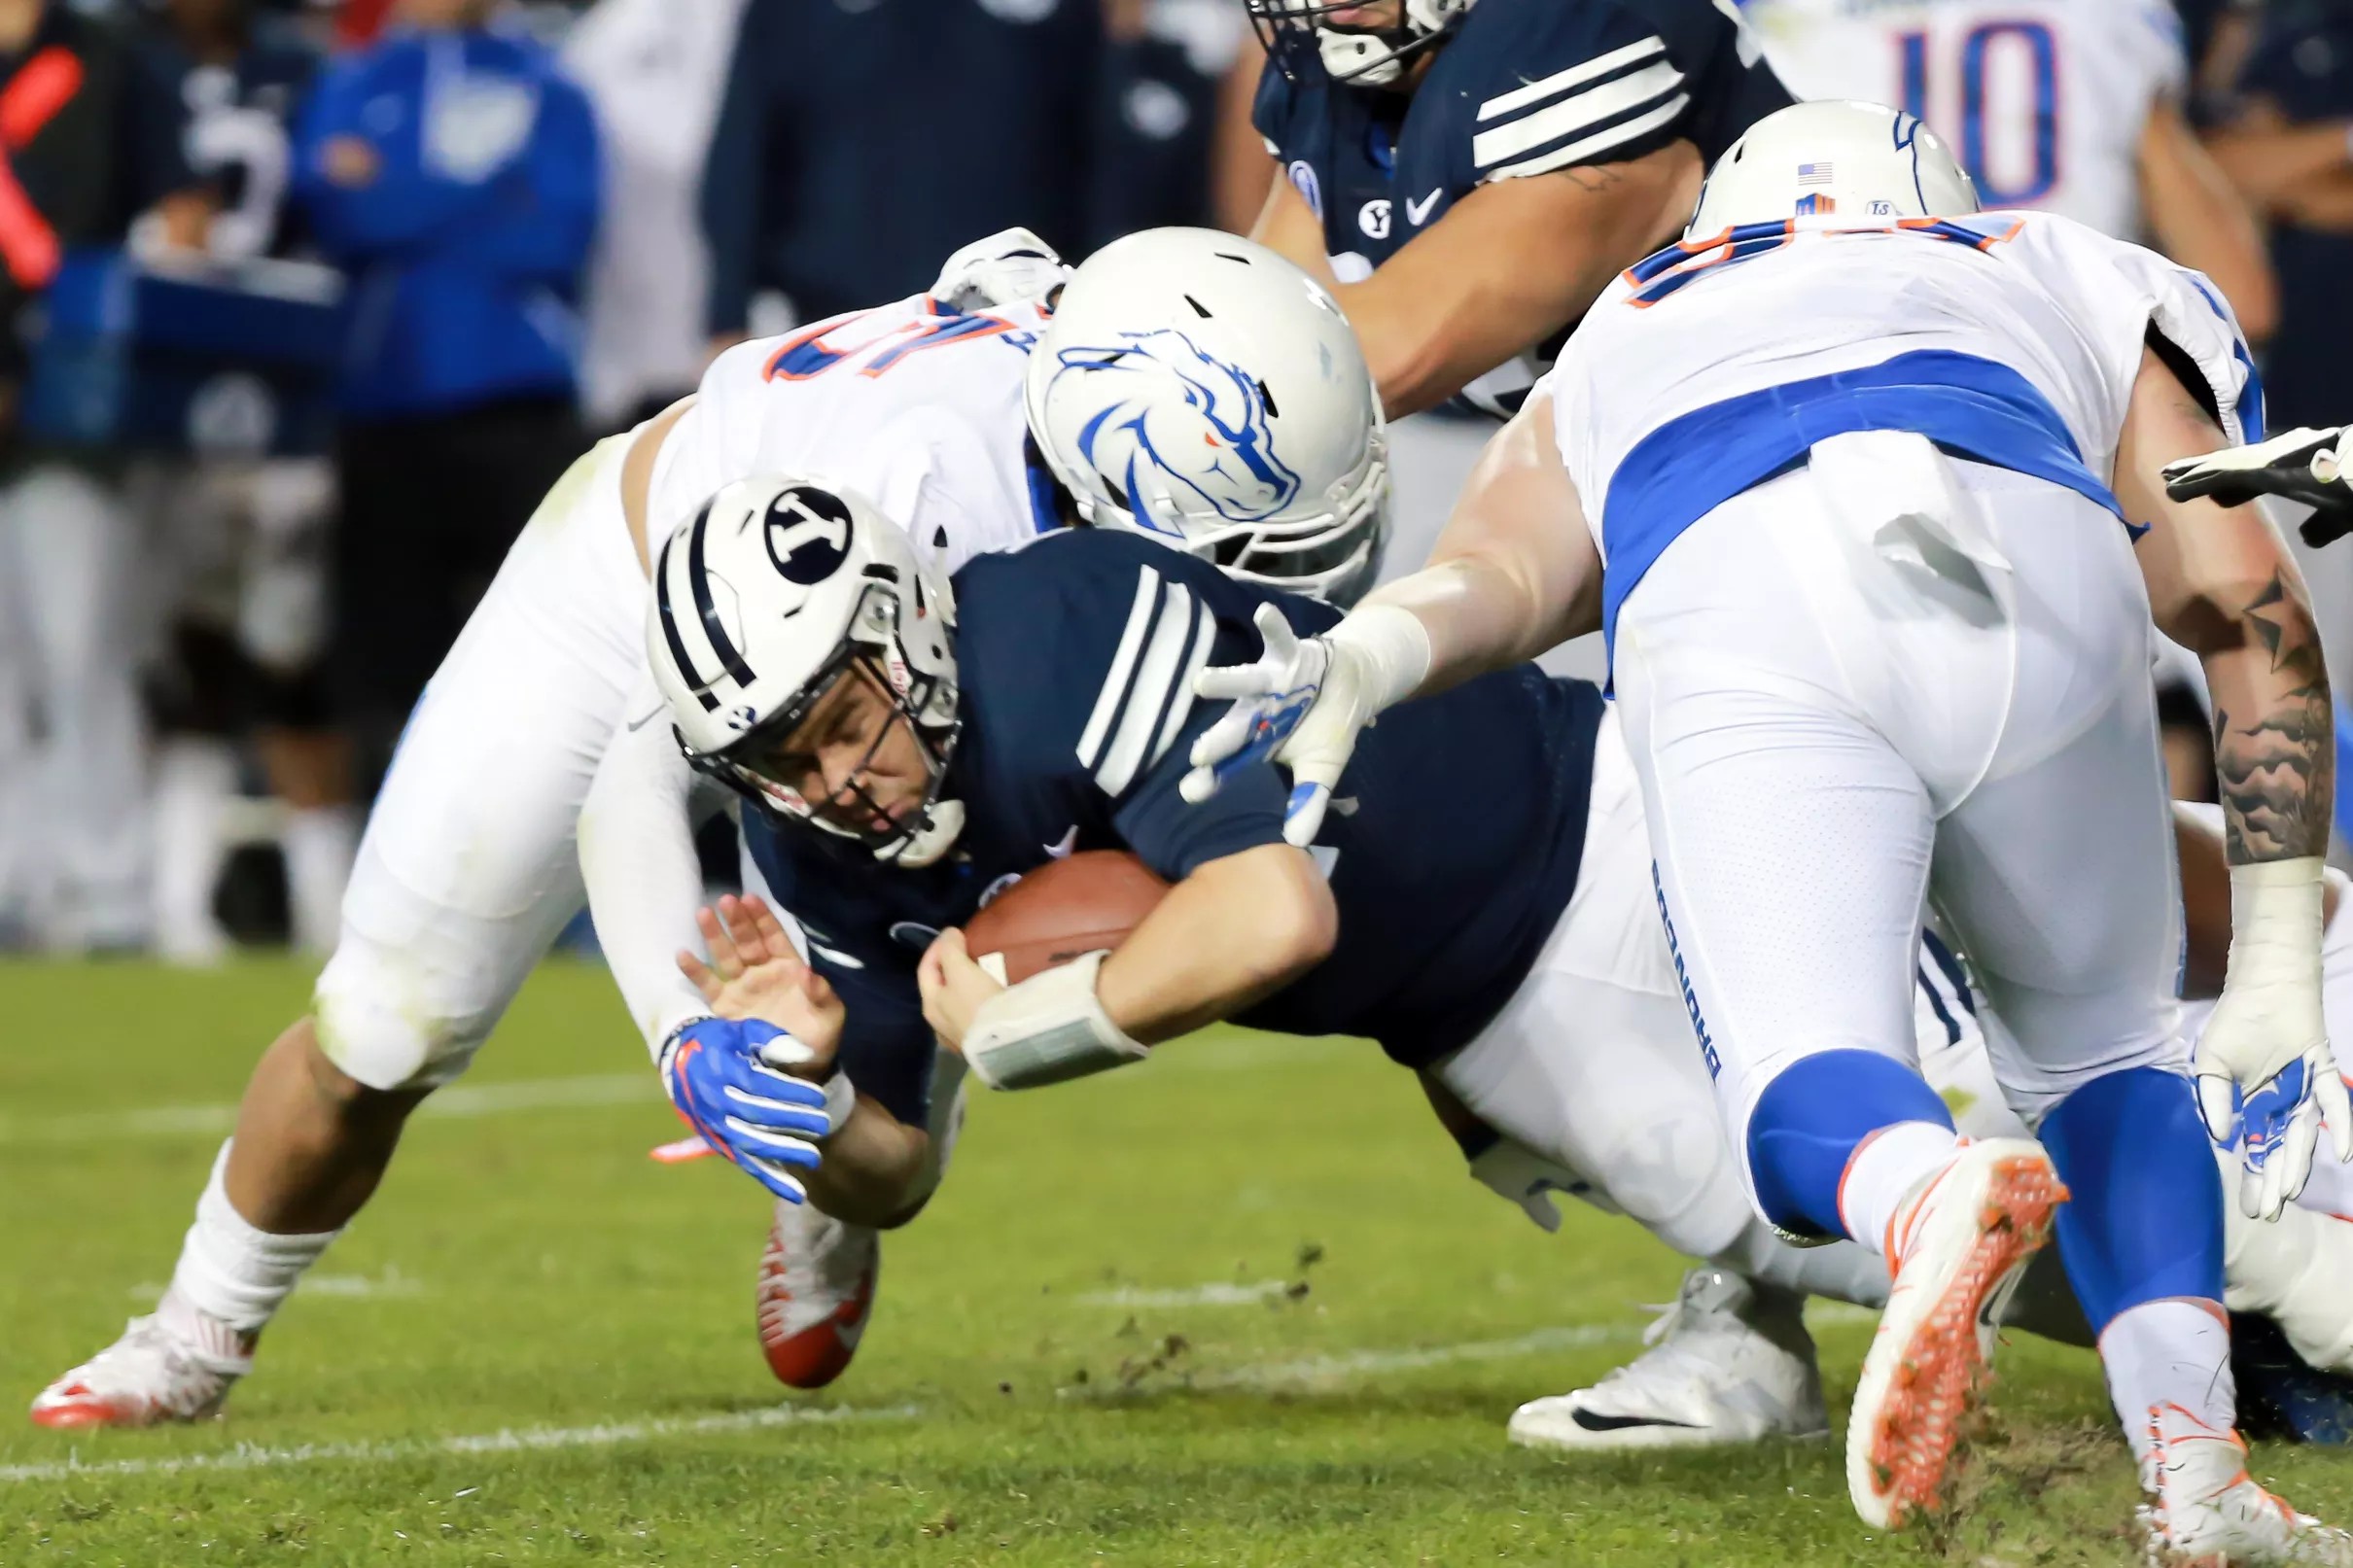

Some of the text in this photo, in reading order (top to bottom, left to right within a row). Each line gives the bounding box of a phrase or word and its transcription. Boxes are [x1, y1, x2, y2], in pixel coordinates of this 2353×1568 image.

[1894, 23, 2059, 210] 10
[1368, 205, 1392, 233] Y
[769, 491, 847, 564] Y
